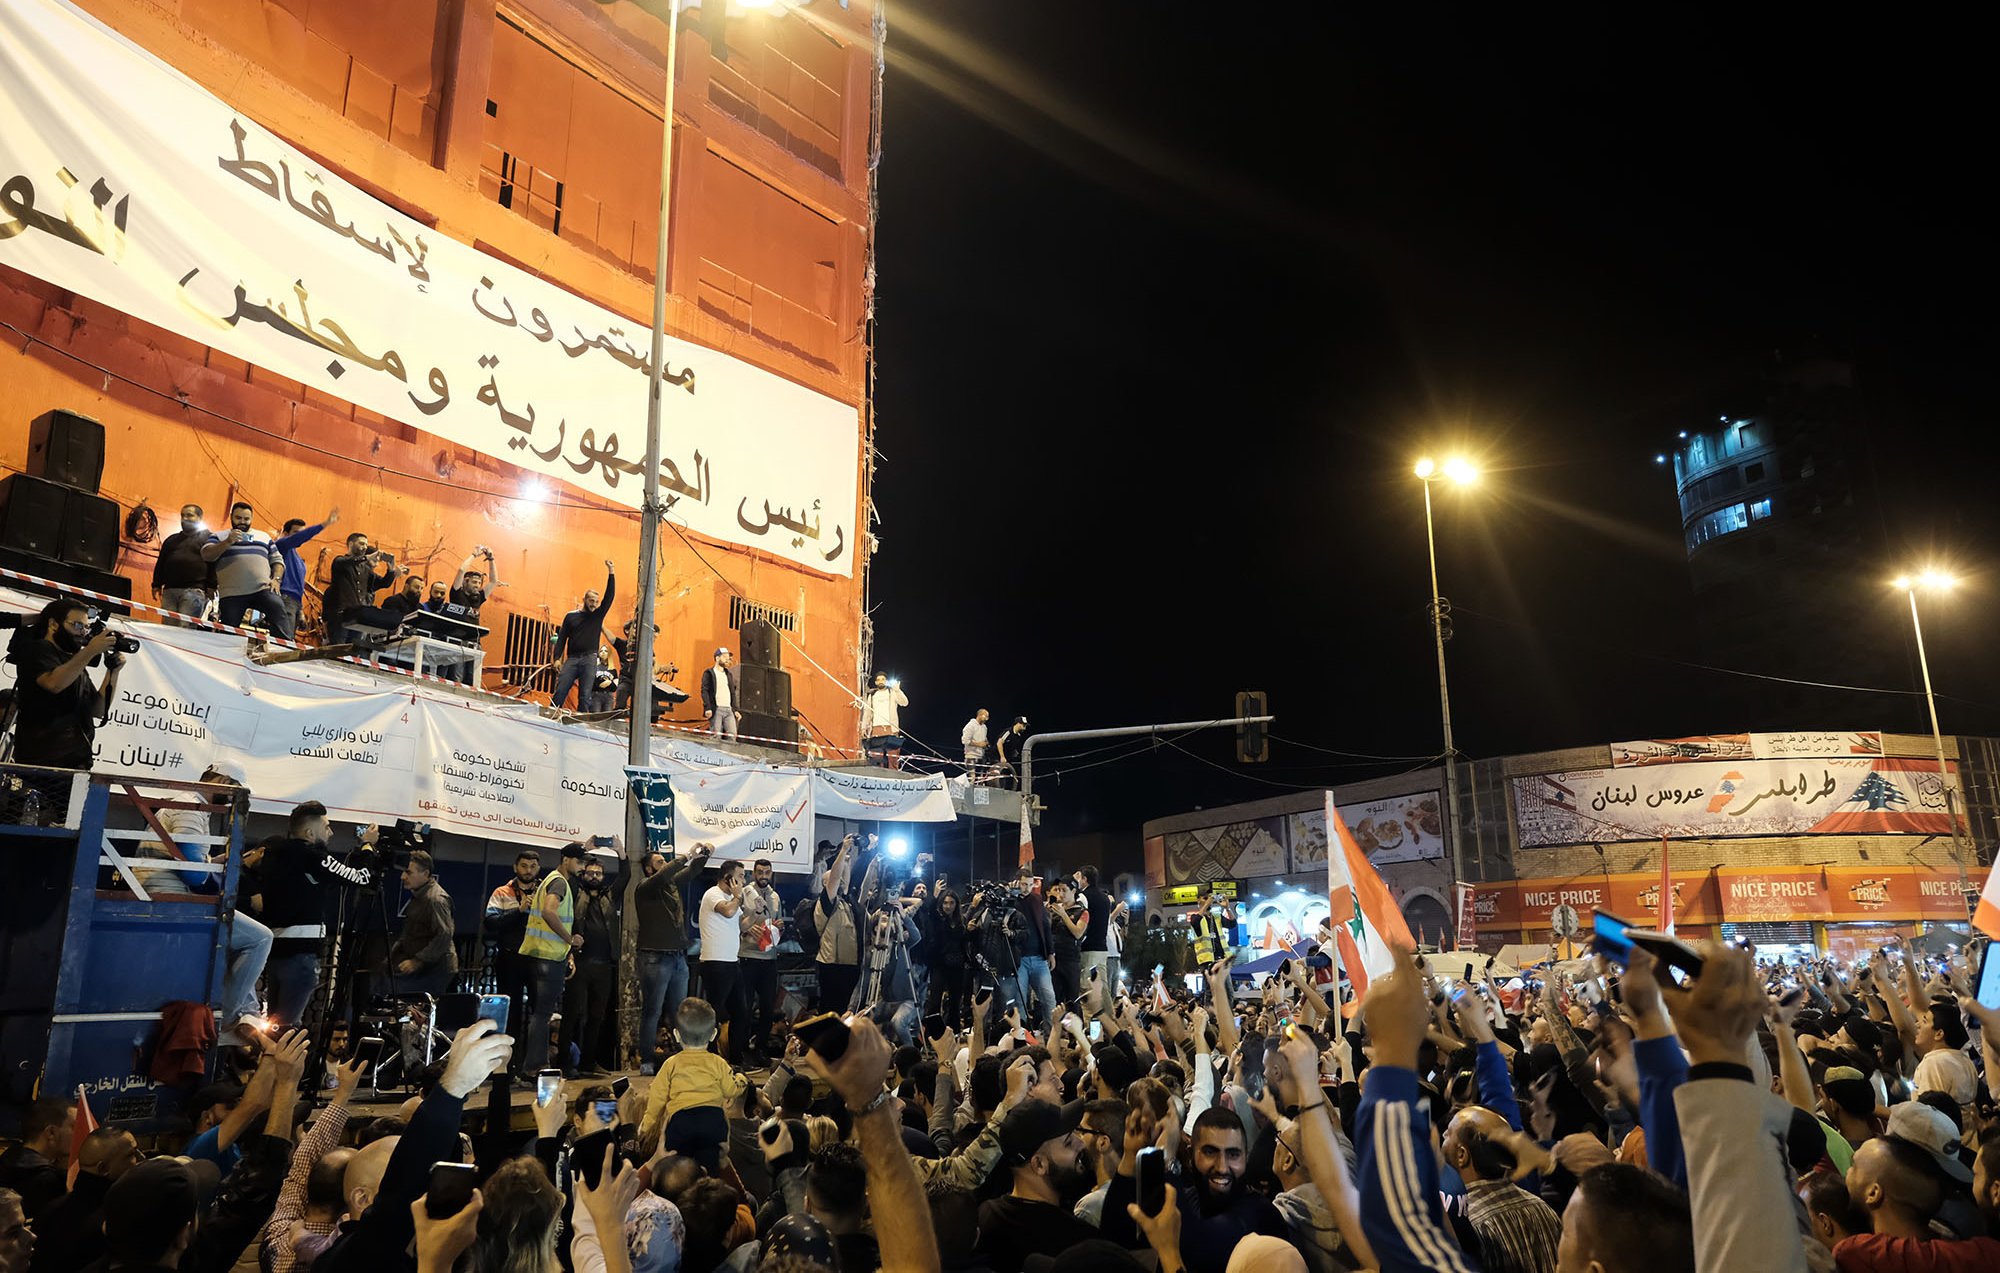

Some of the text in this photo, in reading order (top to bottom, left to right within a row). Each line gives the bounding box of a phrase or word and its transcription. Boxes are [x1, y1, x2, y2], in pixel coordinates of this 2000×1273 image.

[218, 118, 695, 395] مستمرون لإسقاط
[476, 354, 711, 508] الجمهورية
[737, 496, 844, 561] رئيس
[121, 690, 211, 723] إعلان موعد
[401, 713, 408, 724] 4
[302, 723, 383, 746] بيان وزاري يلبي
[290, 745, 379, 764] تطلعات الشعب
[453, 749, 526, 774] تشكيل حكومة
[561, 776, 611, 798] الحكومة
[838, 776, 859, 789] ذات
[860, 778, 890, 793] مدنية
[1592, 769, 1836, 816] طرابلس عروس لبنان
[460, 810, 480, 820] حين
[725, 805, 753, 814] الشعب
[503, 816, 543, 829] الساحات
[568, 827, 580, 835] لن
[720, 820, 727, 828] و
[771, 820, 781, 830] من
[750, 838, 784, 852] طرابلس
[321, 855, 371, 885] SUMMER
[1731, 881, 1817, 898] NICE PRICE
[1856, 888, 1885, 901] PRICE
[1920, 881, 1949, 896] NICE
[1525, 889, 1603, 907] NICE PRICE
[1474, 900, 1495, 914] PRICE
[73, 1077, 119, 1099] الخارجي
[120, 1075, 147, 1092] للنقل
